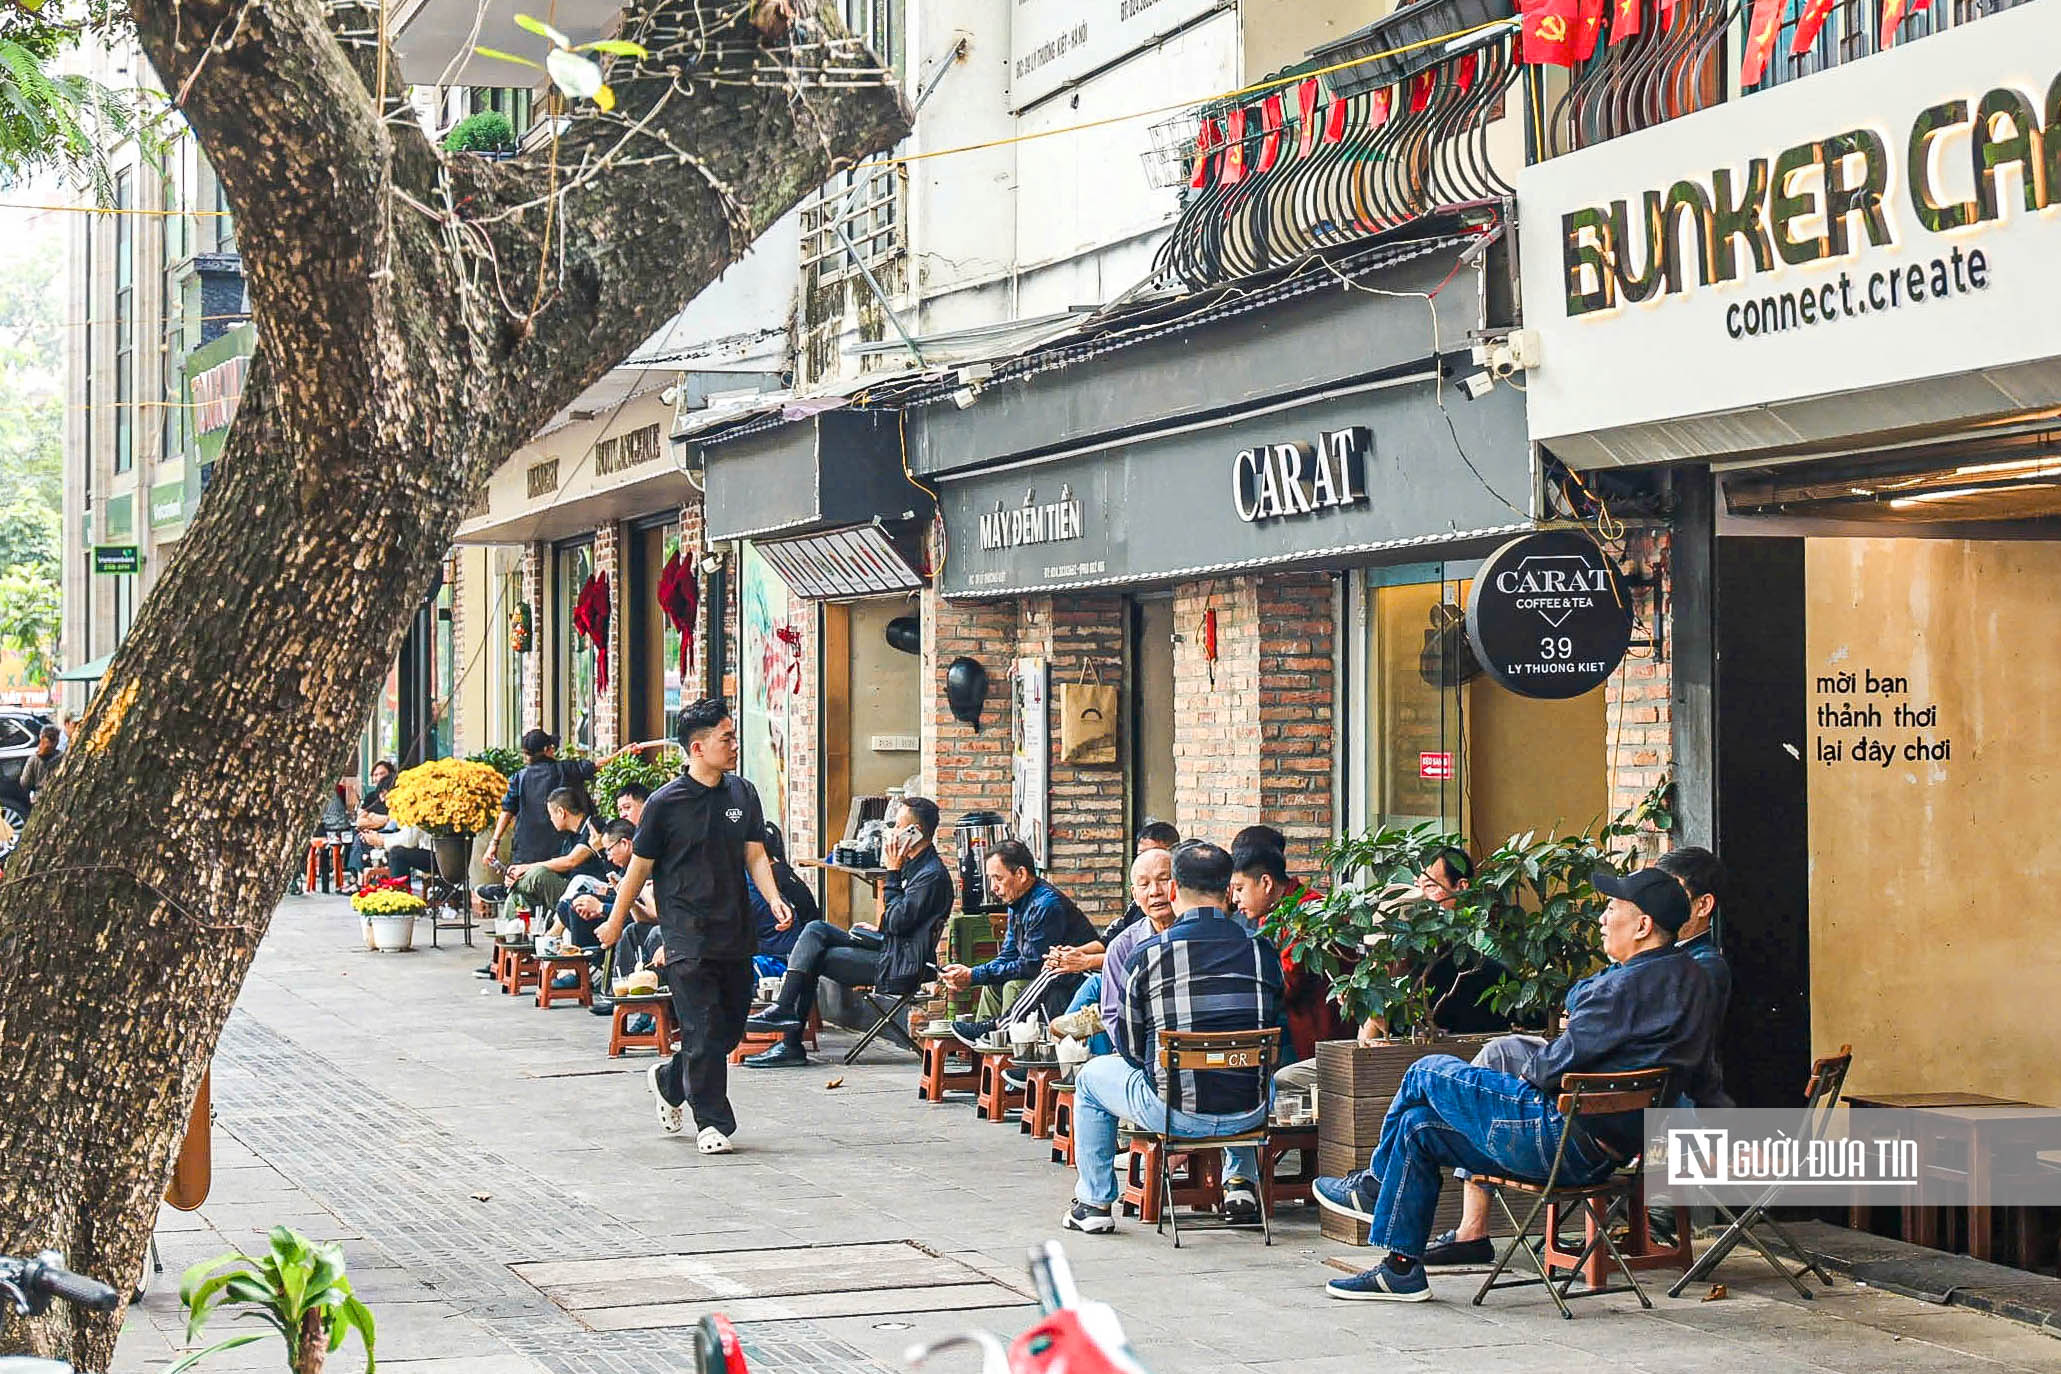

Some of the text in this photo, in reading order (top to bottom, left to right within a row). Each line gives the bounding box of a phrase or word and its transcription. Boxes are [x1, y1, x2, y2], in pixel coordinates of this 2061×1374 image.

[1561, 72, 2061, 317] BUNKER CA
[1727, 246, 1987, 340] connect.create
[1233, 427, 1356, 522] CARAT
[980, 483, 1081, 551] MÁY ĐẾM TIỀN
[1496, 570, 1611, 594] CARAT
[1515, 598, 1560, 609] COFFEE
[1573, 597, 1594, 609] TEA
[1540, 637, 1573, 659] 39
[1508, 662, 1606, 675] LY THUONG KIET
[1816, 668, 1908, 698] mời bạn
[1817, 702, 1937, 728] thảnh thơi
[1817, 735, 1951, 768] lại đây chơi
[1228, 1053, 1248, 1067] CR
